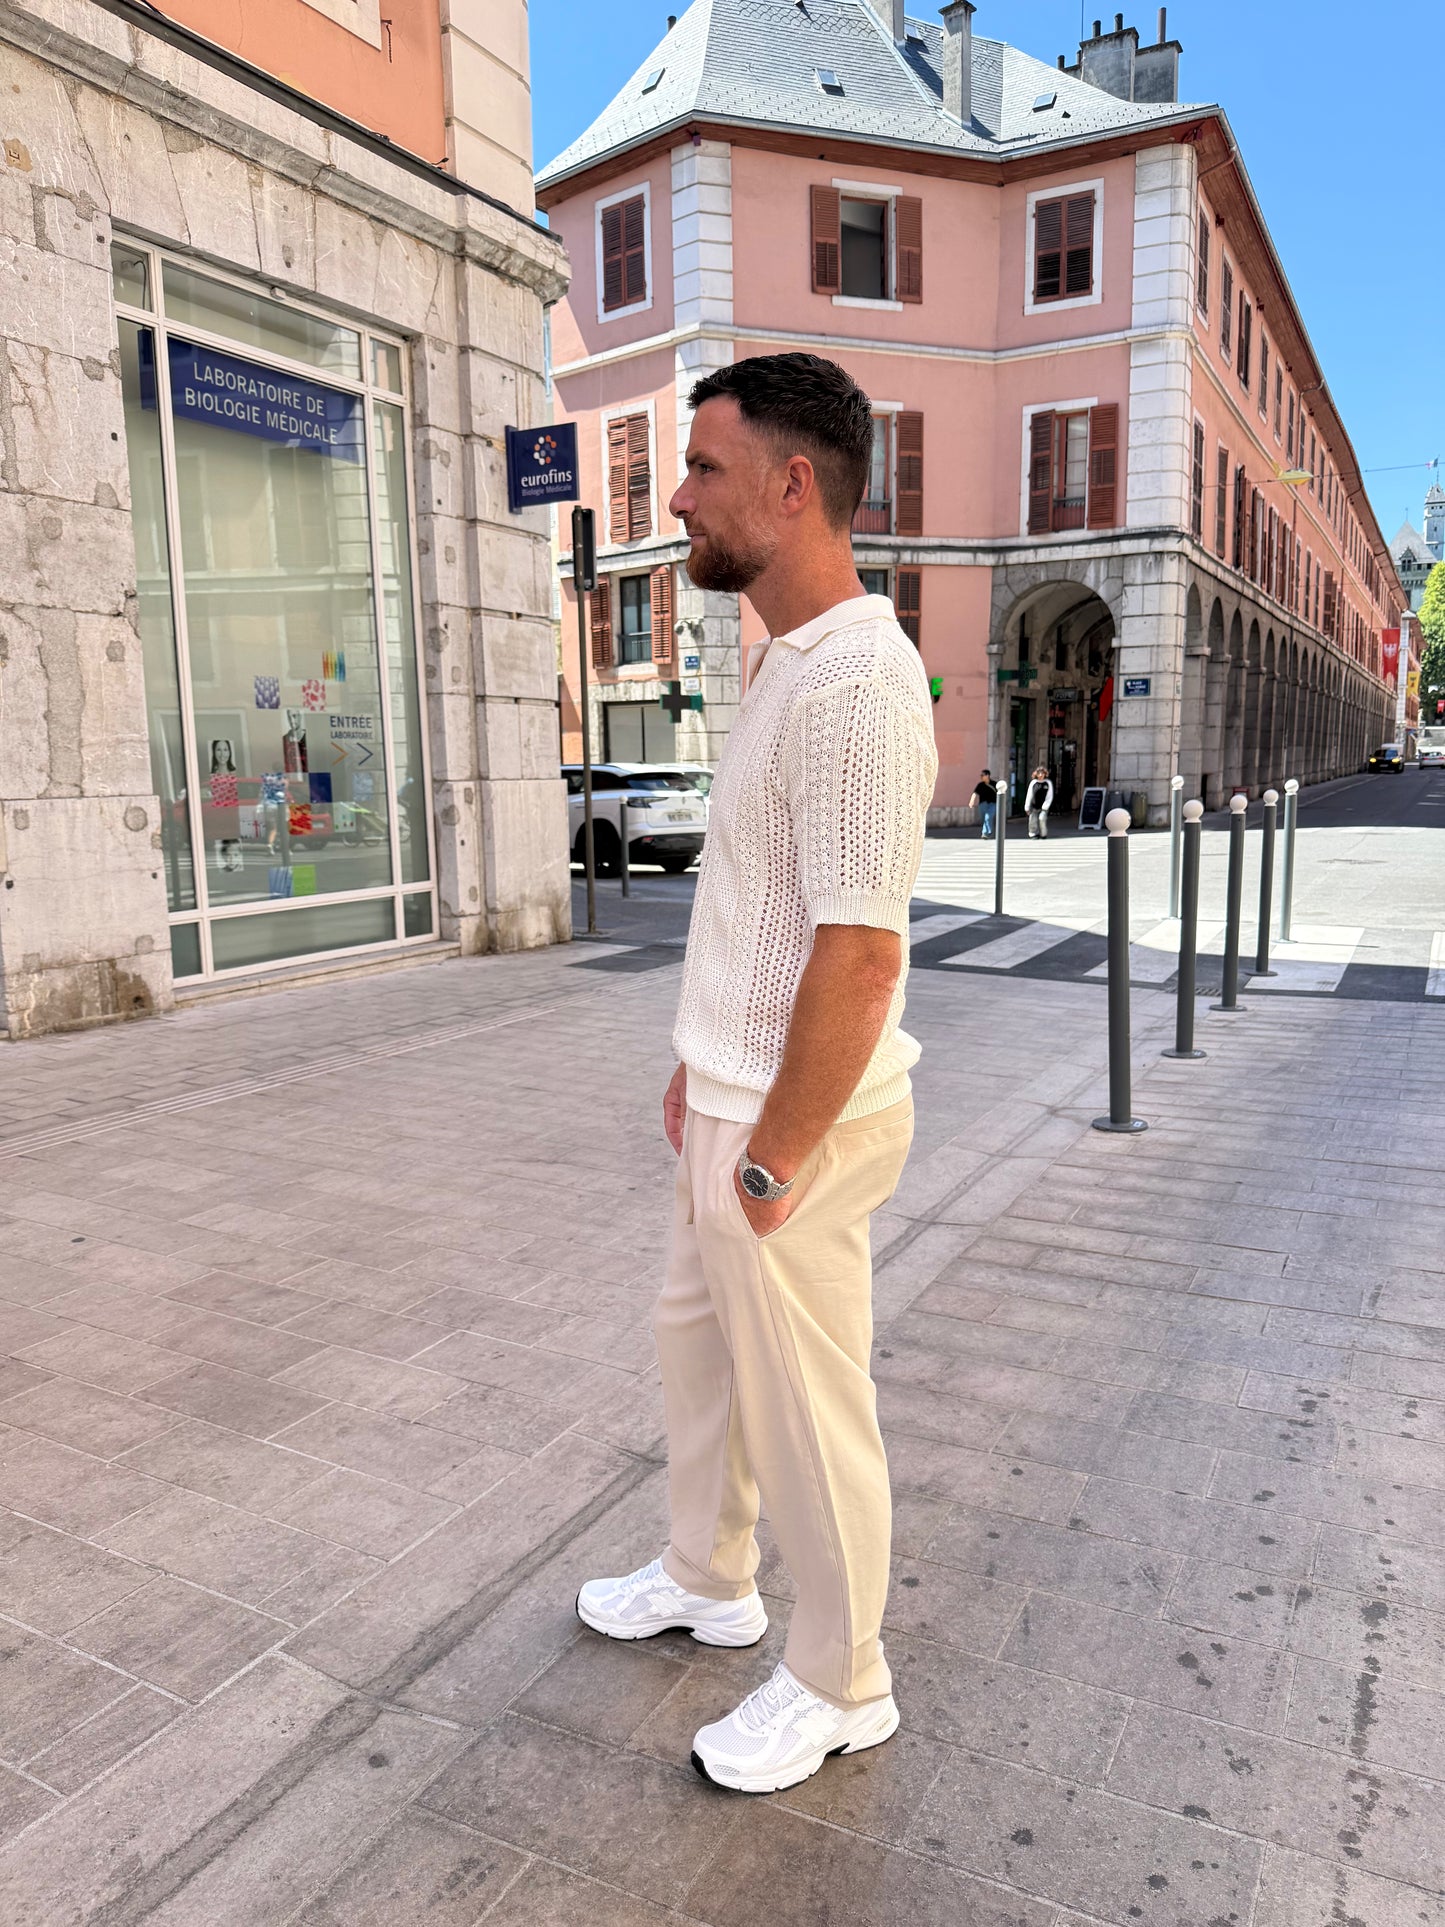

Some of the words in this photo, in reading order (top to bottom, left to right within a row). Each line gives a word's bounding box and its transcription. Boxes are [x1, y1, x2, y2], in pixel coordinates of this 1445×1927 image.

[193, 361, 302, 410] LABORATOIRE
[306, 395, 325, 417] DE
[184, 386, 262, 425] BIOLOGIE
[266, 409, 338, 445] MÉDICALE
[521, 469, 572, 487] eurofins
[330, 714, 372, 728] ENTRÉE
